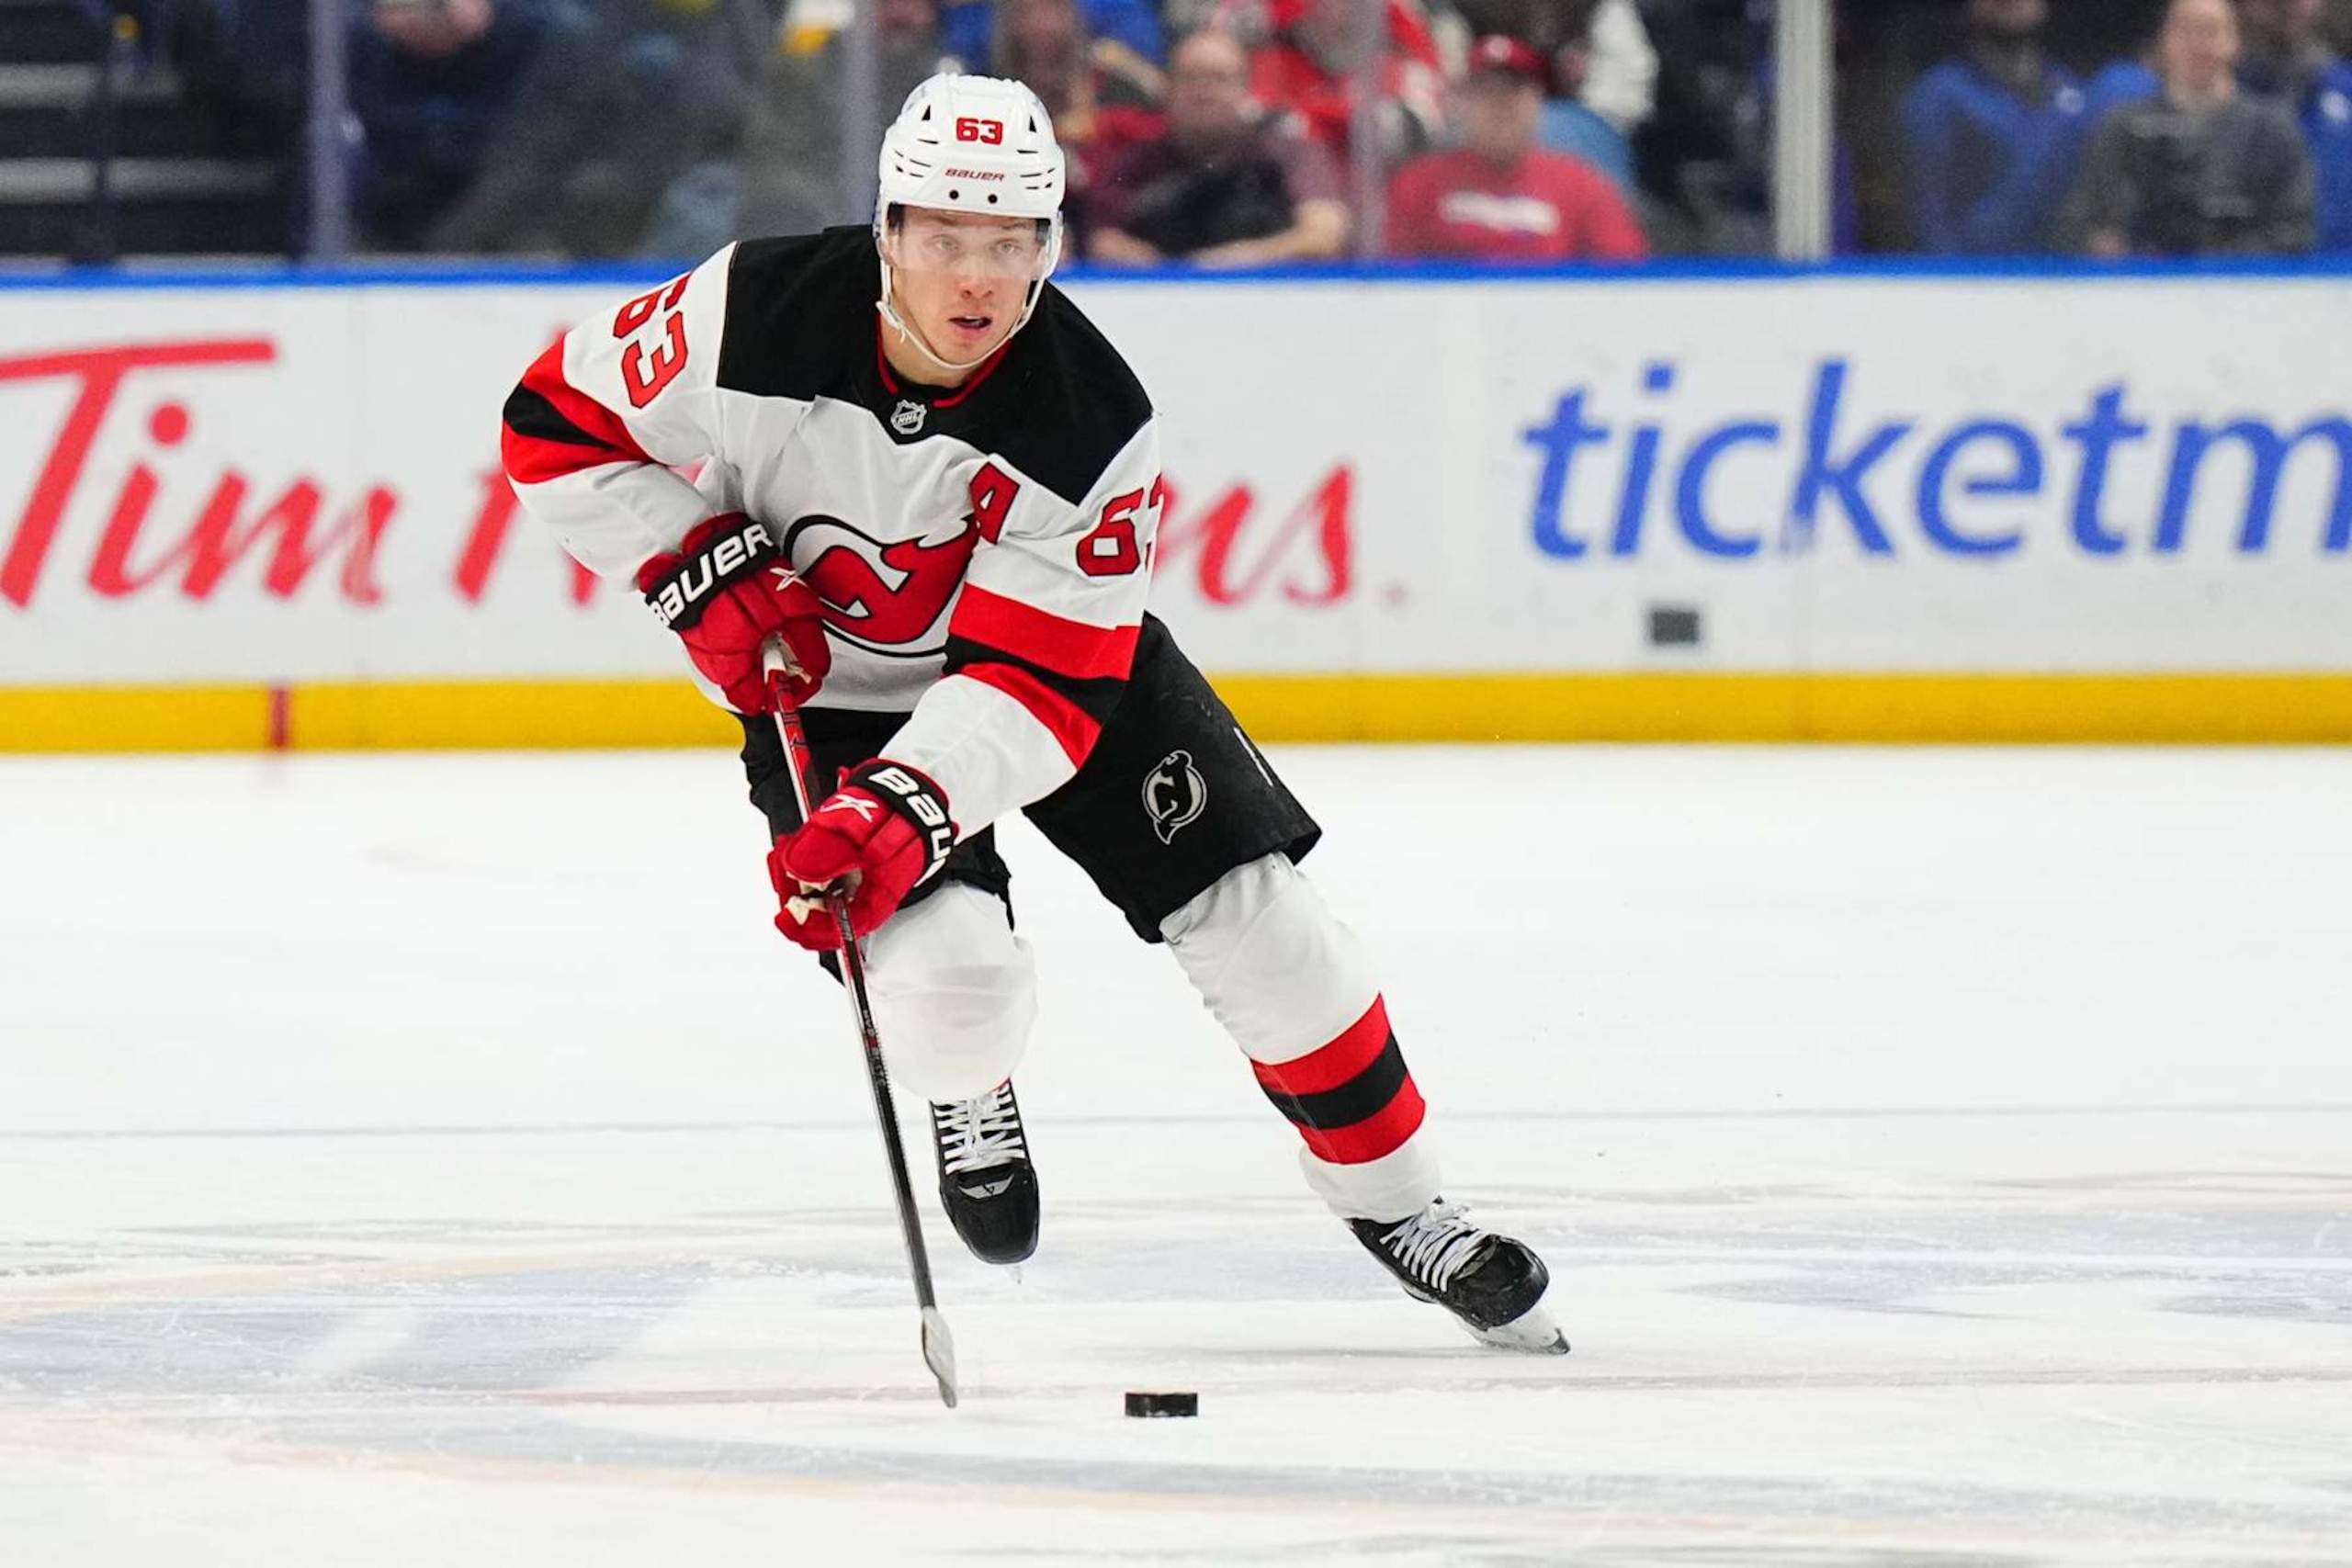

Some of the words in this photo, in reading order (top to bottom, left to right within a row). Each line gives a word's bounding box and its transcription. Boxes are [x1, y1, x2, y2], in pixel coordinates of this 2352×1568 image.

[944, 167, 1005, 183] BAUER
[956, 117, 1003, 145] 63
[0, 338, 401, 610] Tim
[1521, 358, 2352, 558] ticketm
